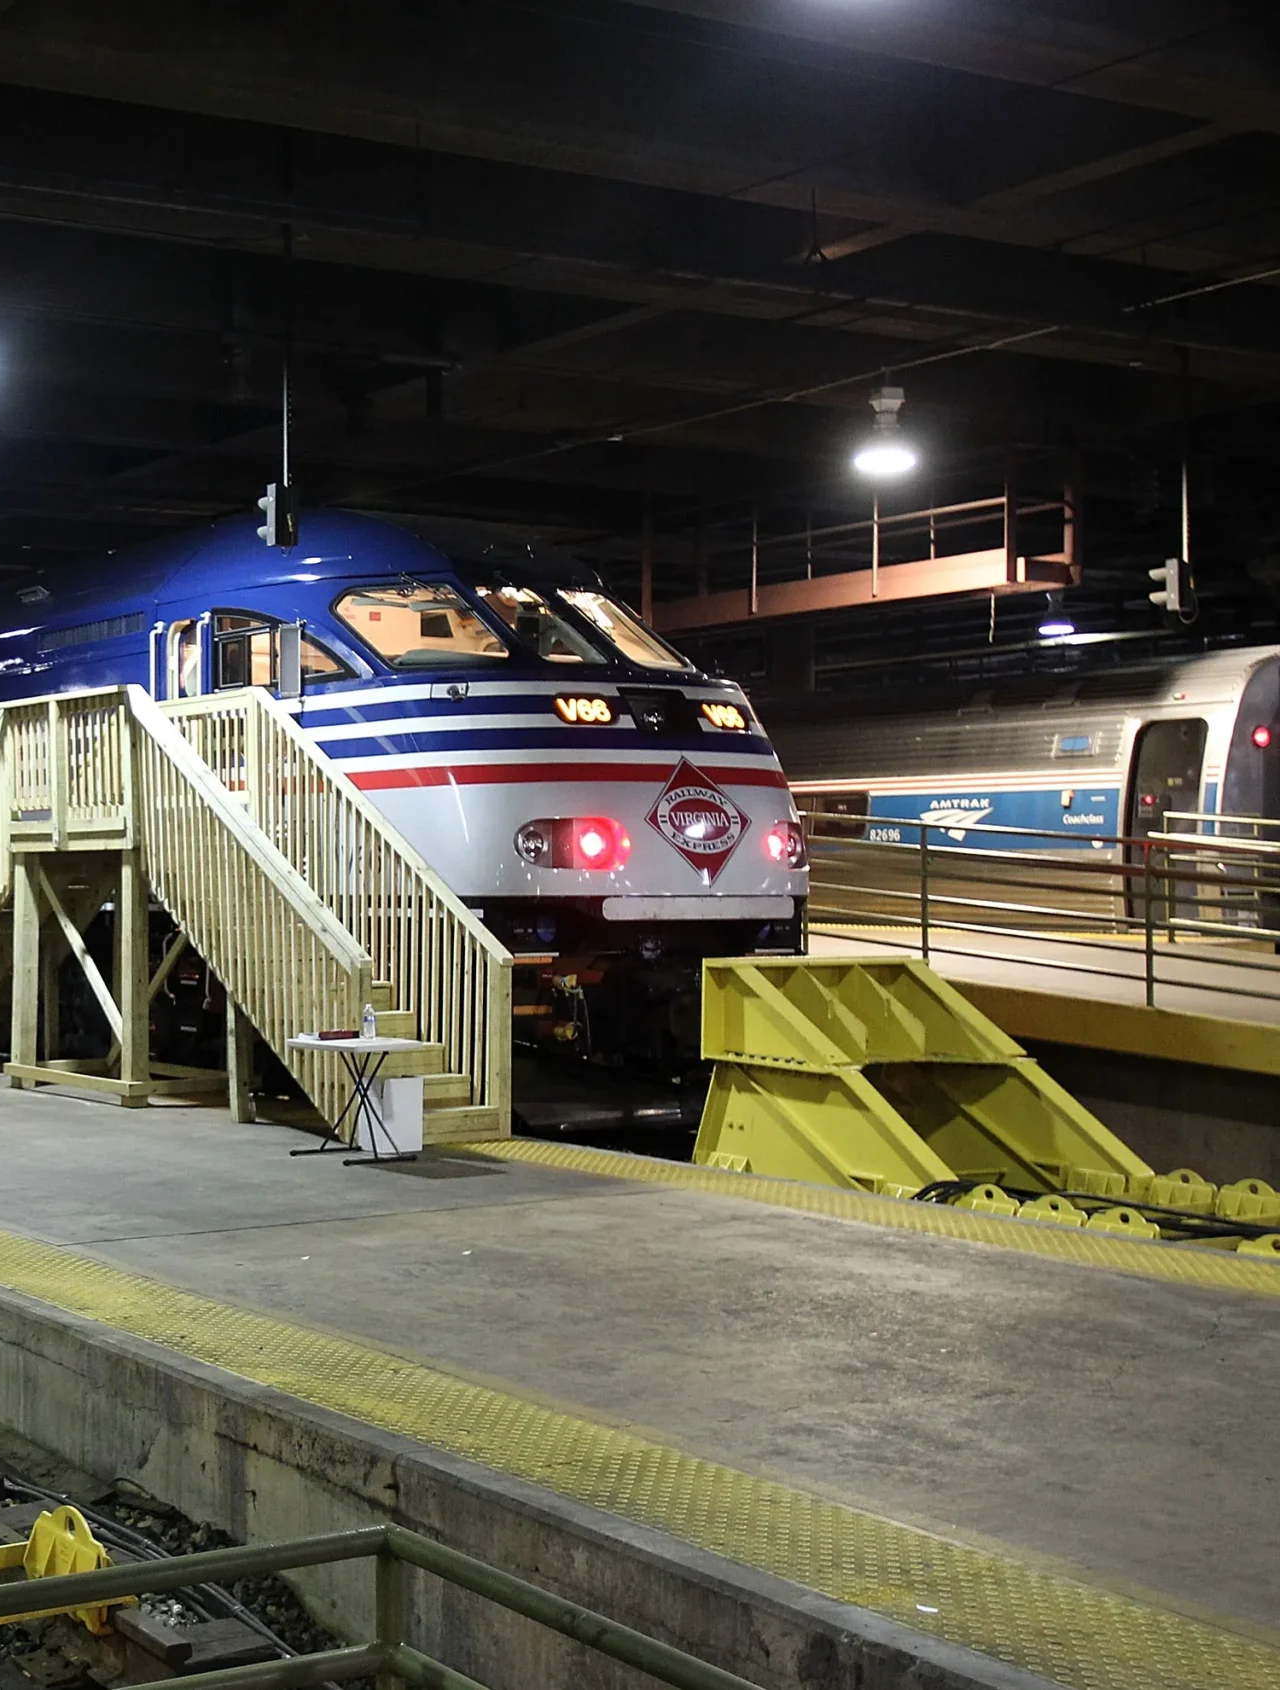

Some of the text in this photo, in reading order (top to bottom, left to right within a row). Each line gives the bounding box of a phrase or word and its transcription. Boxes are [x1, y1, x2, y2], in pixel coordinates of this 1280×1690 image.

[556, 698, 611, 722] V66
[701, 703, 745, 728] V66
[665, 788, 727, 806] RAILWAY
[930, 798, 990, 809] AMTRAK
[670, 811, 729, 827] VIRGINIA
[671, 832, 735, 852] EXPRESS
[870, 828, 900, 841] 82696
